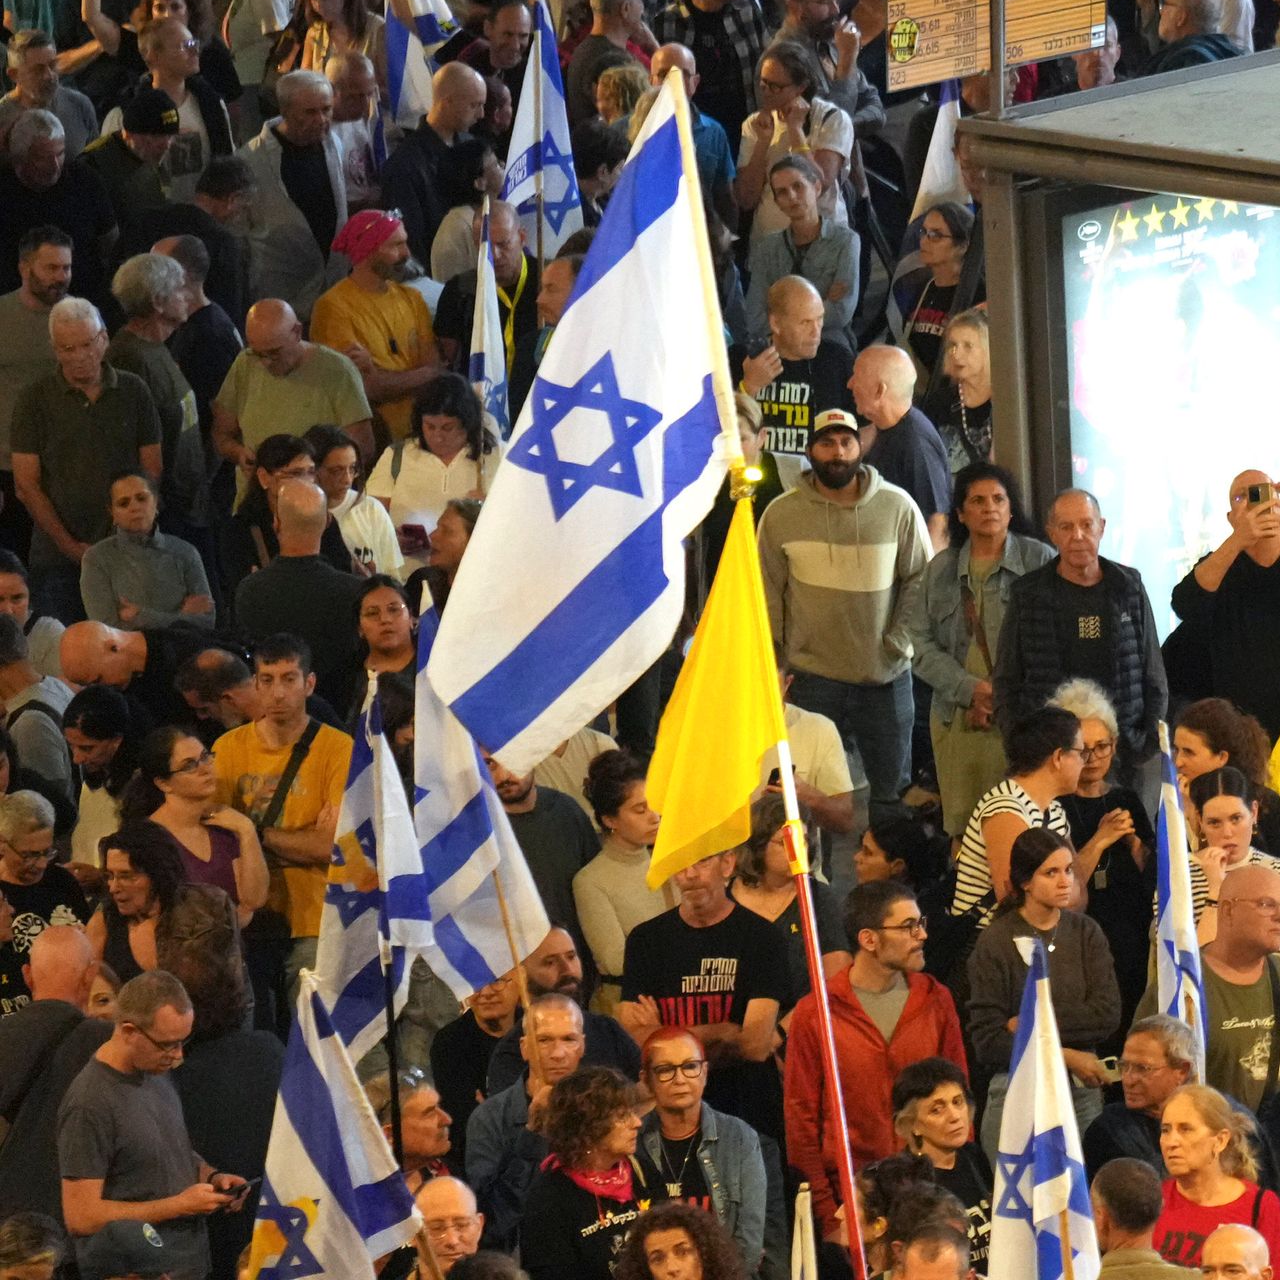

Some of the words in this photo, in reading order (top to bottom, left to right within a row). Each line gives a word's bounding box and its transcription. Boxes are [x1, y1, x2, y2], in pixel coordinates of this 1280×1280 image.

[889, 2, 905, 18] 532
[1006, 44, 1023, 59] 506
[780, 382, 810, 404] למה
[763, 402, 809, 427] עדיי
[764, 426, 809, 452] בעזה
[701, 958, 739, 976] מחזירים
